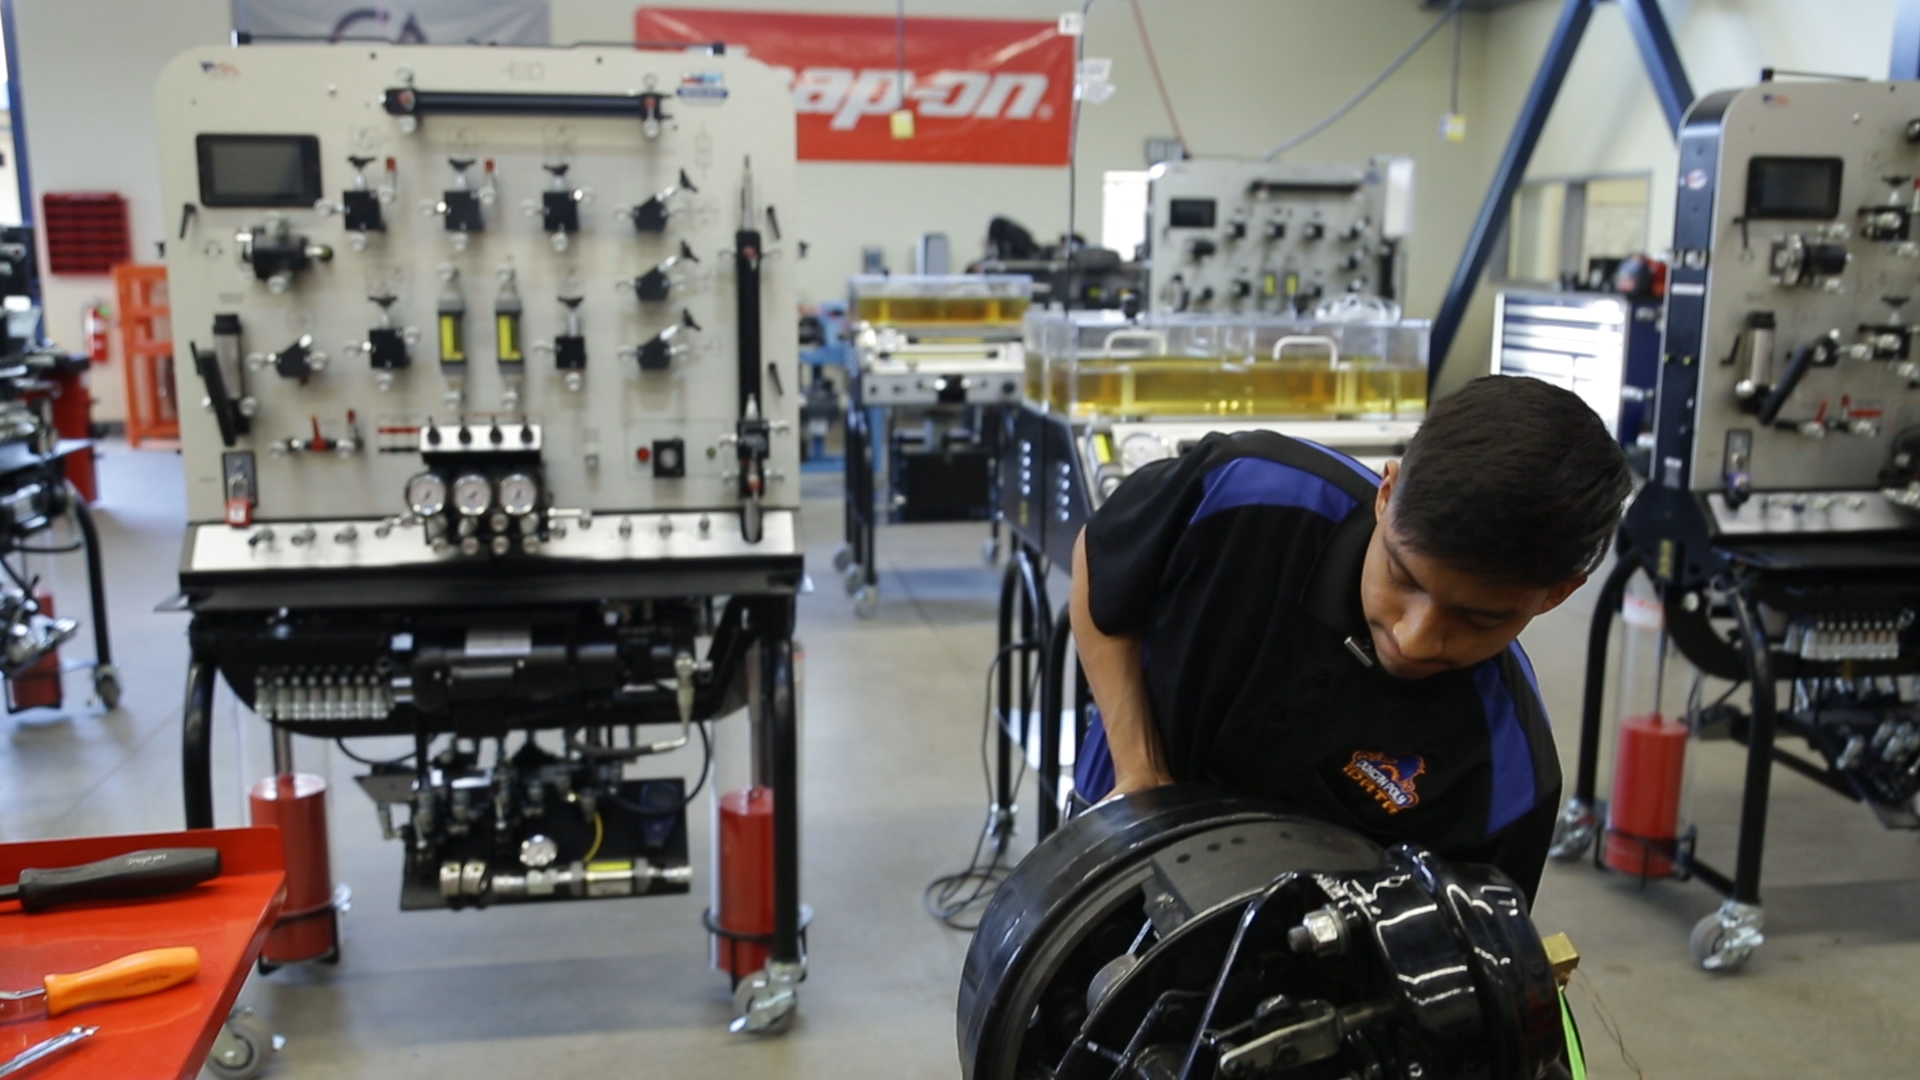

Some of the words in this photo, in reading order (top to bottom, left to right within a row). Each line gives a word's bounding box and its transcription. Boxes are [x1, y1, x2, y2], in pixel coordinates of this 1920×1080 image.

[772, 66, 1049, 130] ap-on
[1356, 759, 1390, 787] DUNCAN
[1383, 782, 1407, 804] POLY
